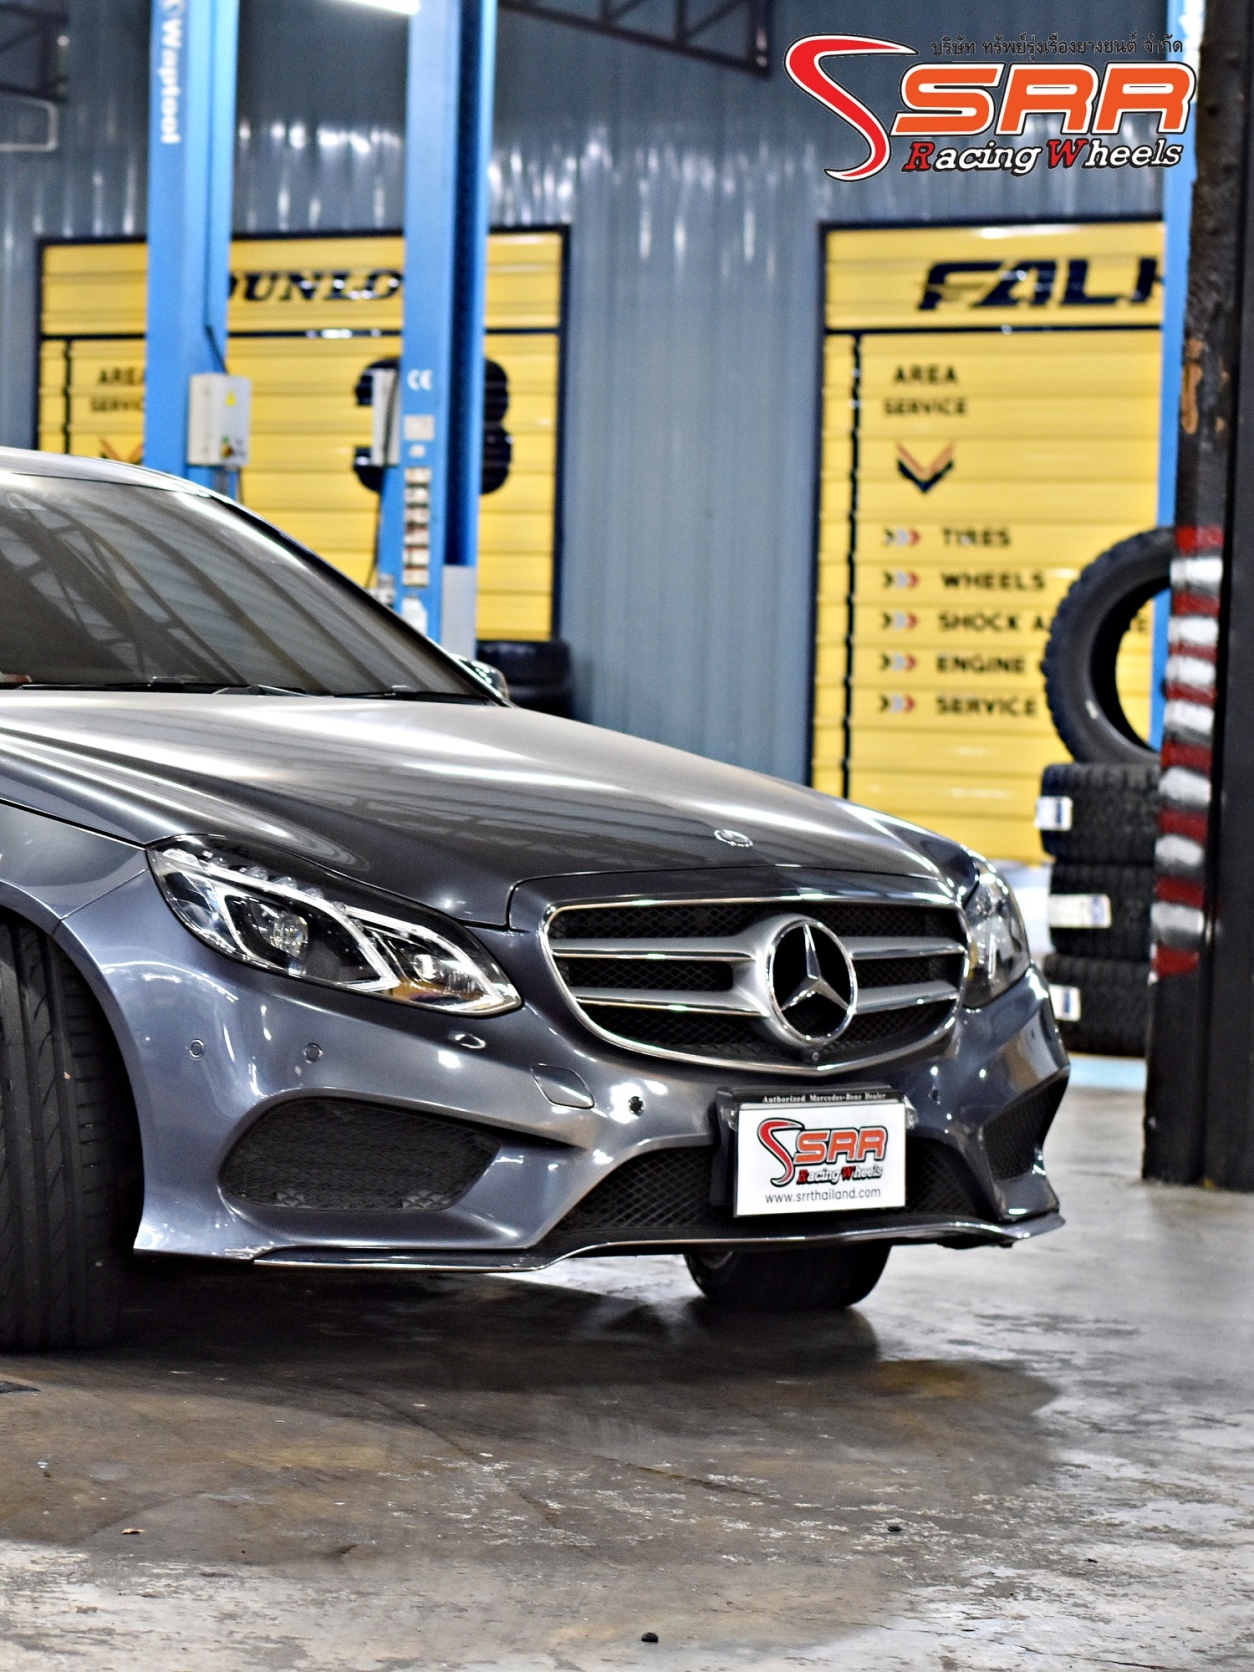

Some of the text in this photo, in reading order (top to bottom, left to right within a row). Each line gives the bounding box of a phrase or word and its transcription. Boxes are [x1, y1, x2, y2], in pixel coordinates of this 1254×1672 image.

[230, 269, 404, 301] UNLO
[893, 366, 958, 384] AREA
[884, 398, 967, 415] SERVICE
[943, 528, 1011, 546] TIRES
[941, 571, 1045, 590] WHEELS
[938, 612, 1019, 632] SHOCK
[936, 654, 1025, 674] ENGINE
[936, 696, 1037, 716] SERVICE
[762, 1091, 886, 1103] Authorized Mercedes-Benz Dealer
[797, 1164, 883, 1185] Racing Wheels
[765, 1187, 881, 1204] www.srrthailand.com
